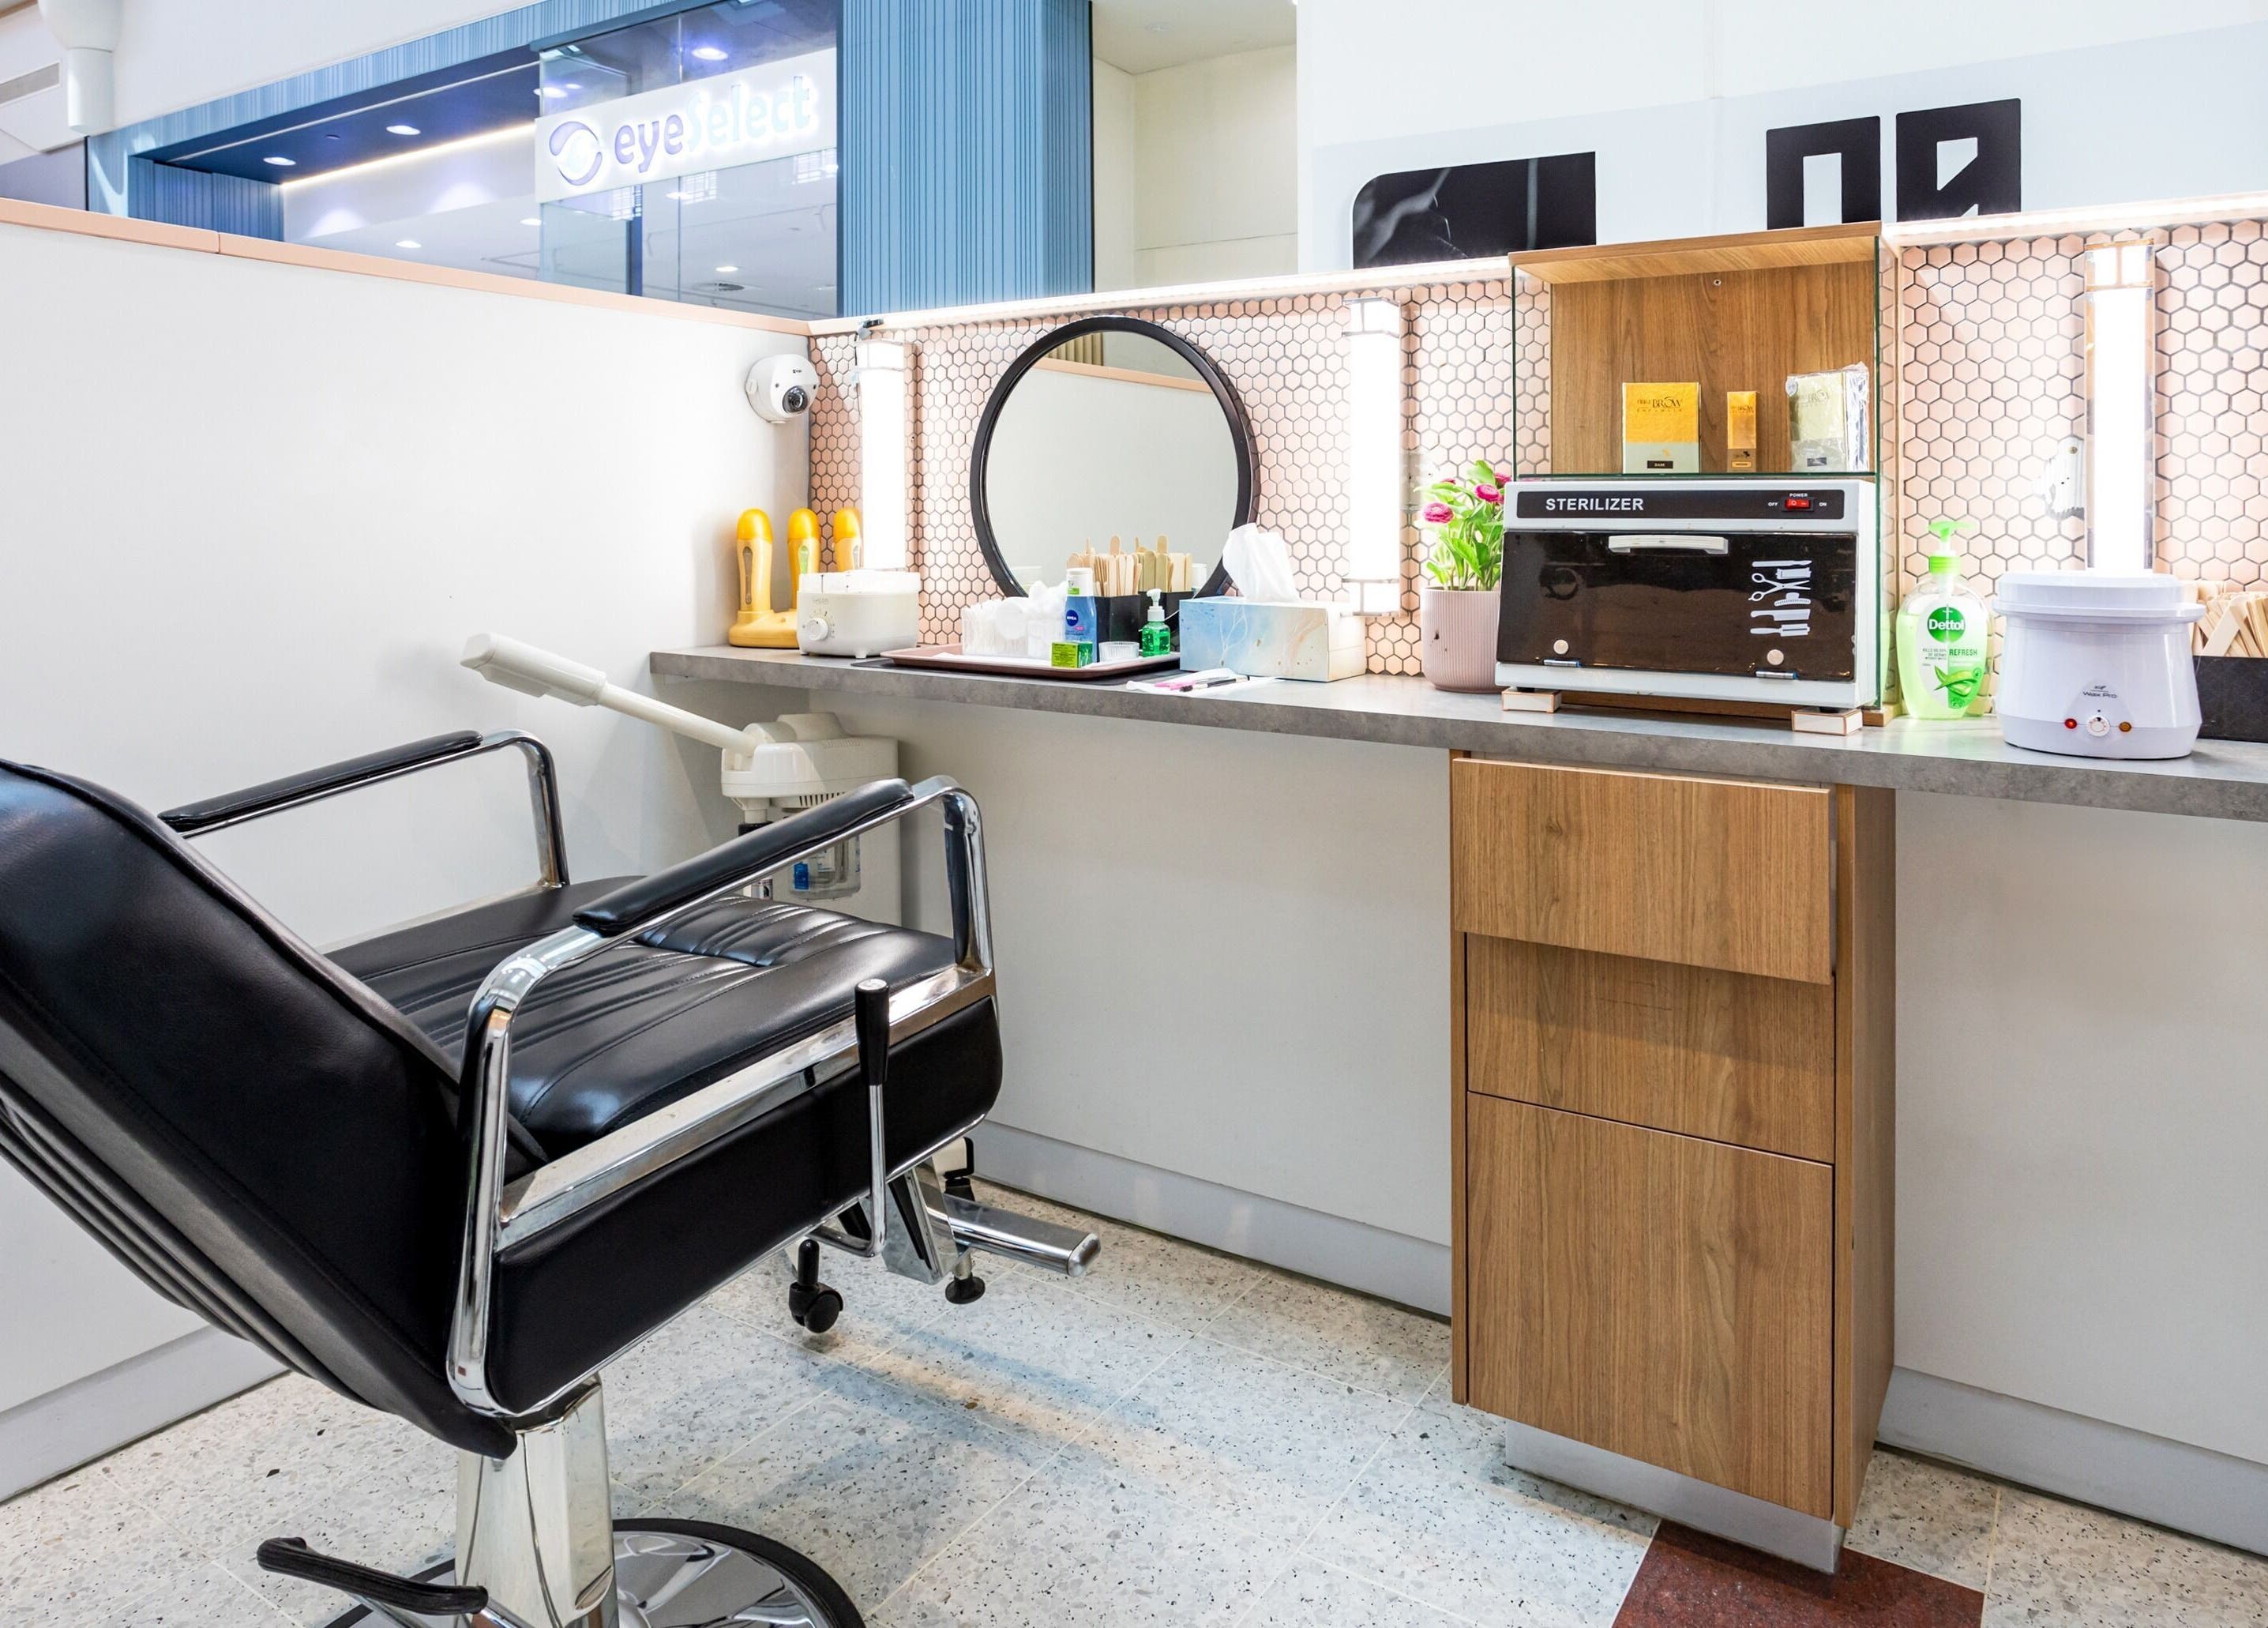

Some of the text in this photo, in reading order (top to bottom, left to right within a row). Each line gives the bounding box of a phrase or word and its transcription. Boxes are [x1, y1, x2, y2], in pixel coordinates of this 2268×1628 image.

[614, 75, 810, 173] eyeSelect
[1545, 498, 1644, 510] STERILIZER
[1928, 618, 1965, 630] Dettol
